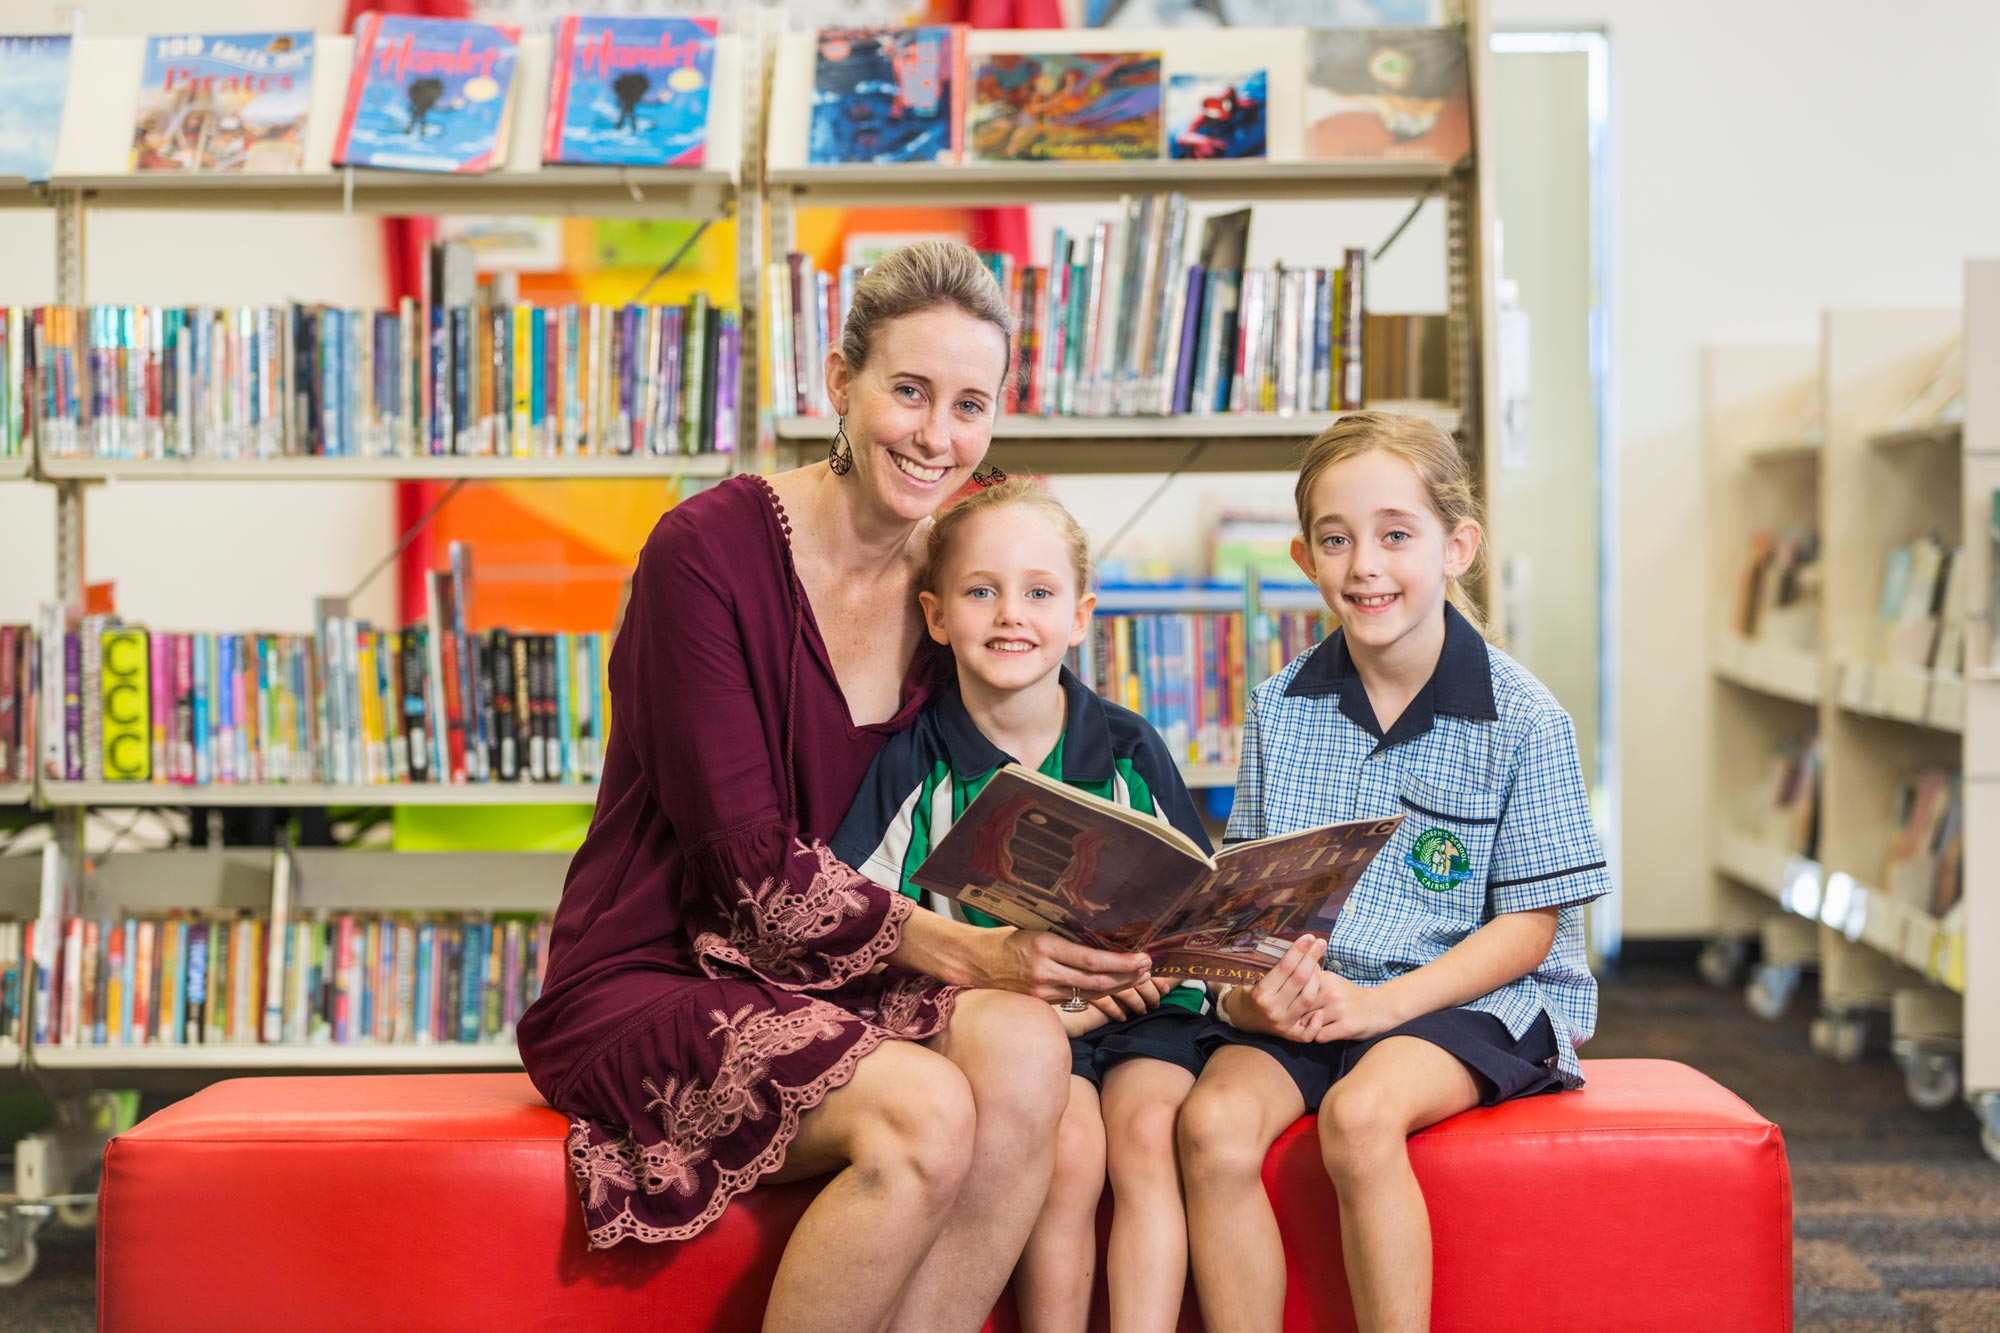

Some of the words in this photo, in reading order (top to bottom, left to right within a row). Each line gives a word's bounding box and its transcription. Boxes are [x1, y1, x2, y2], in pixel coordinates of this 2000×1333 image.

[157, 35, 204, 60] 100
[379, 33, 505, 82] Hamlet
[580, 29, 707, 78] Hamlet
[164, 66, 294, 93] Pirates
[1375, 821, 1395, 834] C
[1415, 841, 1422, 852] ST
[1421, 830, 1449, 843] JOSEPH'S
[1450, 836, 1467, 863] SCHOOL
[1421, 877, 1450, 890] CAIRNS
[1151, 966, 1181, 974] OD
